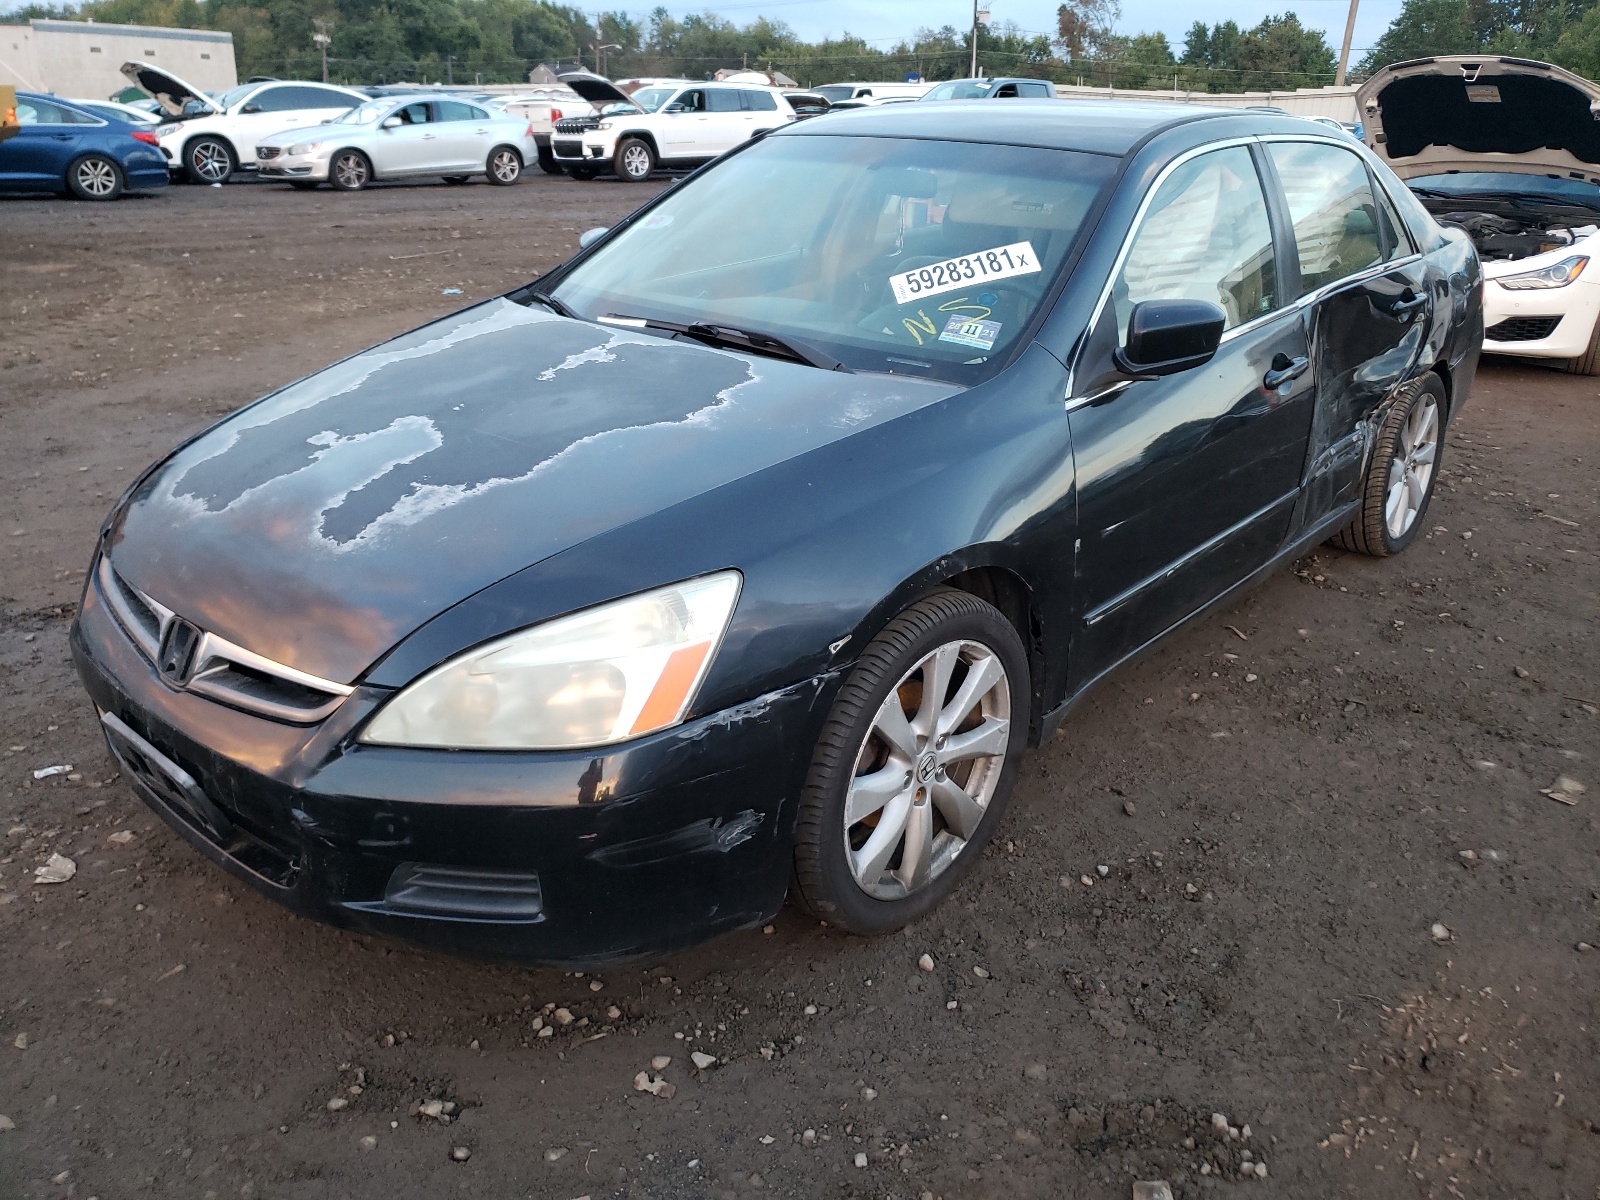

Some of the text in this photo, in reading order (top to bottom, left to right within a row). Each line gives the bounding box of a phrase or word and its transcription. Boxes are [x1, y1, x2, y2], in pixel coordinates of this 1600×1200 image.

[905, 248, 1015, 293] 59283181
[964, 324, 979, 335] 11
[981, 329, 995, 338] 21
